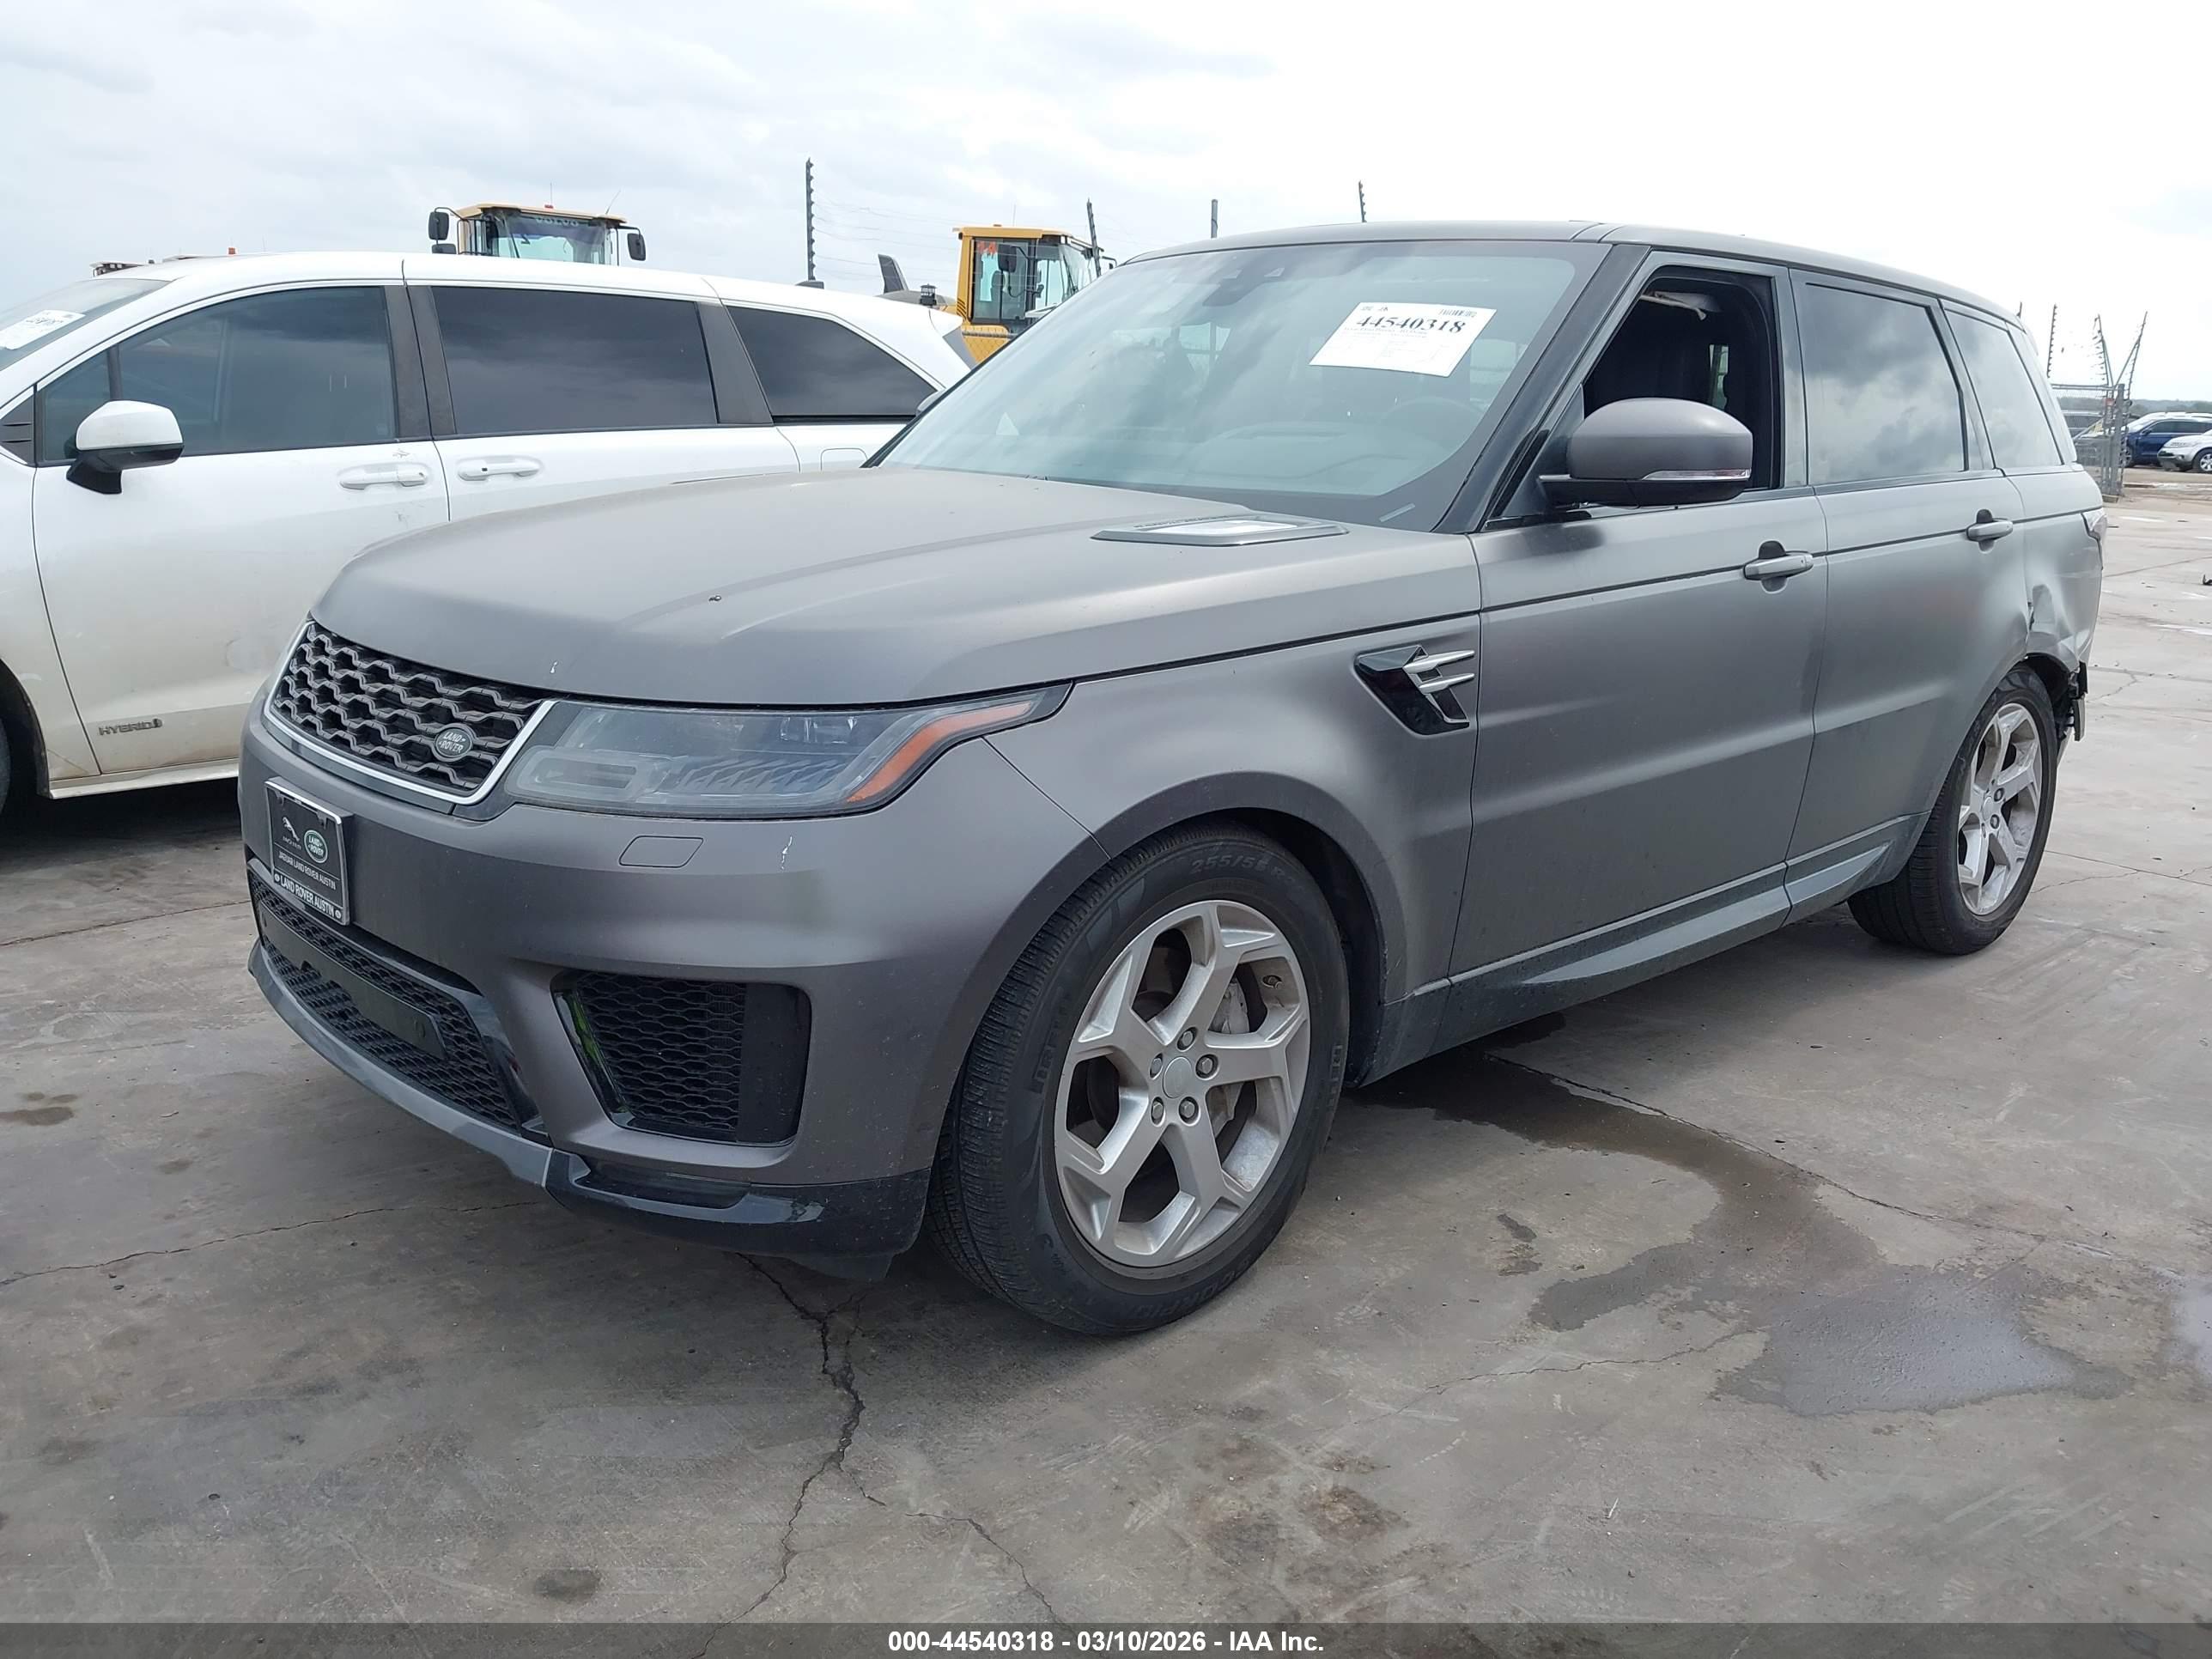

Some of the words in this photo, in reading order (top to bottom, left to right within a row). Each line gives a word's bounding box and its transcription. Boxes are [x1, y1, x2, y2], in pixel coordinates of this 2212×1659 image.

[1357, 315, 1466, 334] 44540318
[98, 721, 153, 736] HYBRID
[443, 732, 463, 743] LAND
[440, 740, 464, 754] ROVER
[308, 836, 320, 848] LAND
[309, 843, 325, 857] ROVER
[294, 859, 305, 873] LAND
[305, 866, 319, 881] ROVER
[319, 873, 336, 890] AUSTIN
[280, 876, 295, 893] LAND
[295, 884, 314, 906] ROVER
[313, 896, 335, 918] AUSTIN
